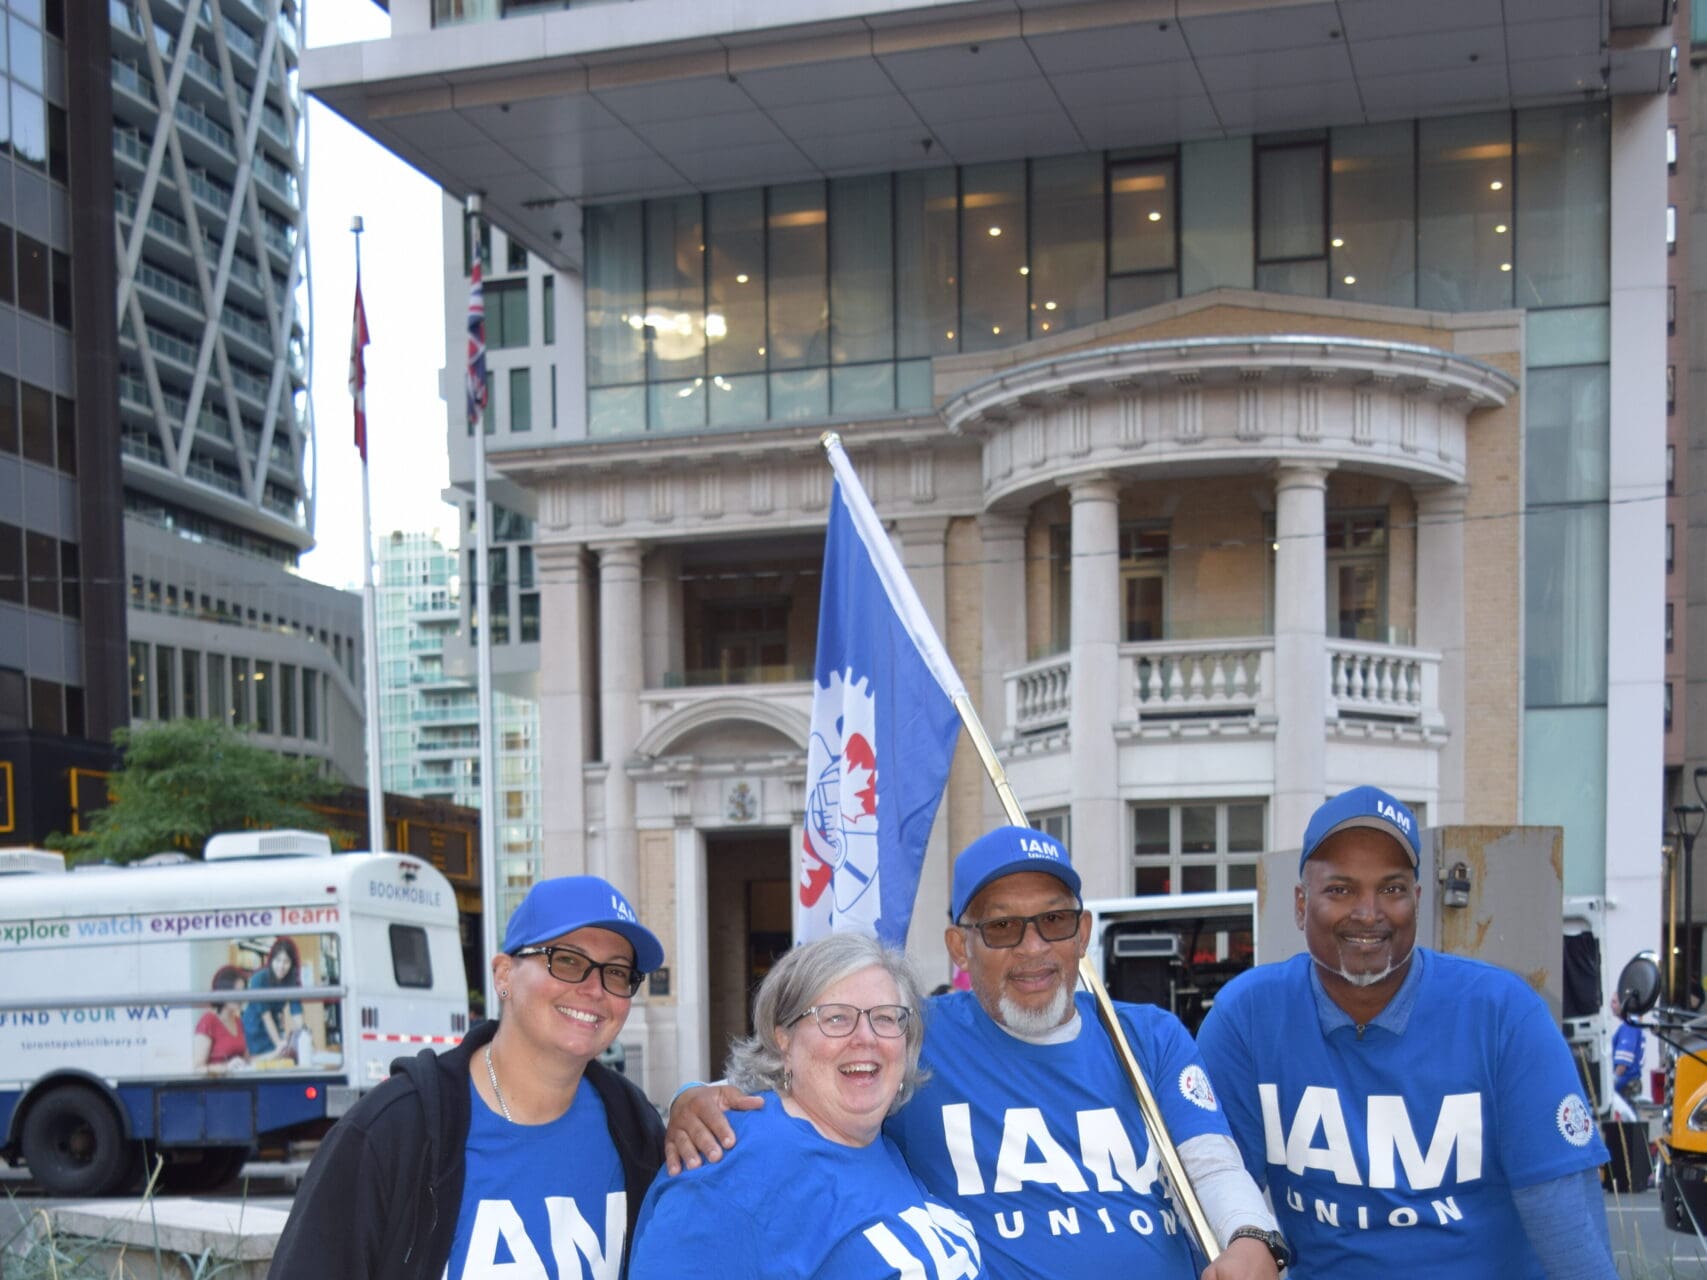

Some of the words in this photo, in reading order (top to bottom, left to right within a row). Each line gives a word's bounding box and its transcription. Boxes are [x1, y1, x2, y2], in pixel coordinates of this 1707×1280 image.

[1377, 799, 1410, 831] IAM
[1020, 838, 1059, 858] IAM
[369, 880, 442, 908] BOOKMOBILE
[0, 919, 71, 945] xplore
[77, 915, 143, 937] watch
[150, 908, 273, 937] experience
[279, 905, 340, 926] learn
[60, 1006, 117, 1025] YOUR
[126, 1005, 172, 1022] WAY
[1258, 1083, 1483, 1190] IAM
[994, 1206, 1177, 1240] UNION
[1286, 1187, 1463, 1230] UNION
